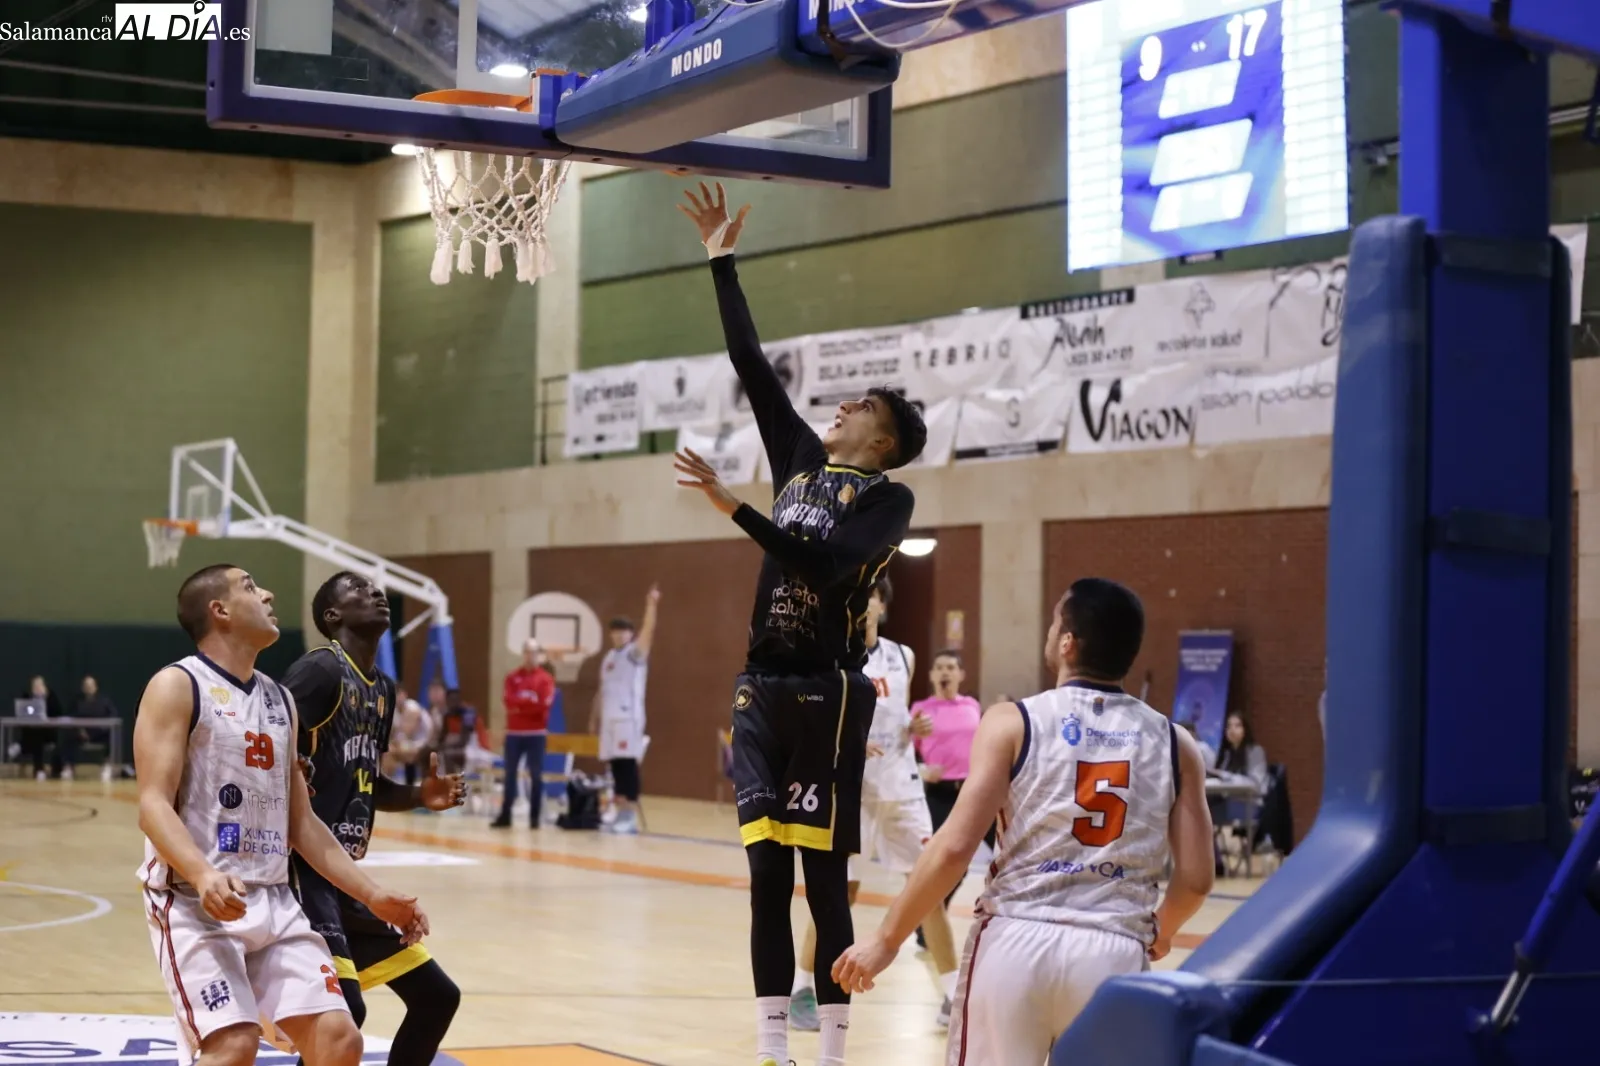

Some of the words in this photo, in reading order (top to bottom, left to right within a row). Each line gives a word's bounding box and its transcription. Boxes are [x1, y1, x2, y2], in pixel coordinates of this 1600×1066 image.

[671, 38, 722, 77] MONDO
[1139, 35, 1162, 81] 9
[1226, 8, 1267, 60] 17
[913, 339, 1011, 369] TEBRIO
[244, 730, 274, 771] 29
[786, 782, 819, 812] 26
[1072, 760, 1130, 847] 5
[243, 841, 259, 853] DE
[244, 827, 282, 842] XUNTA
